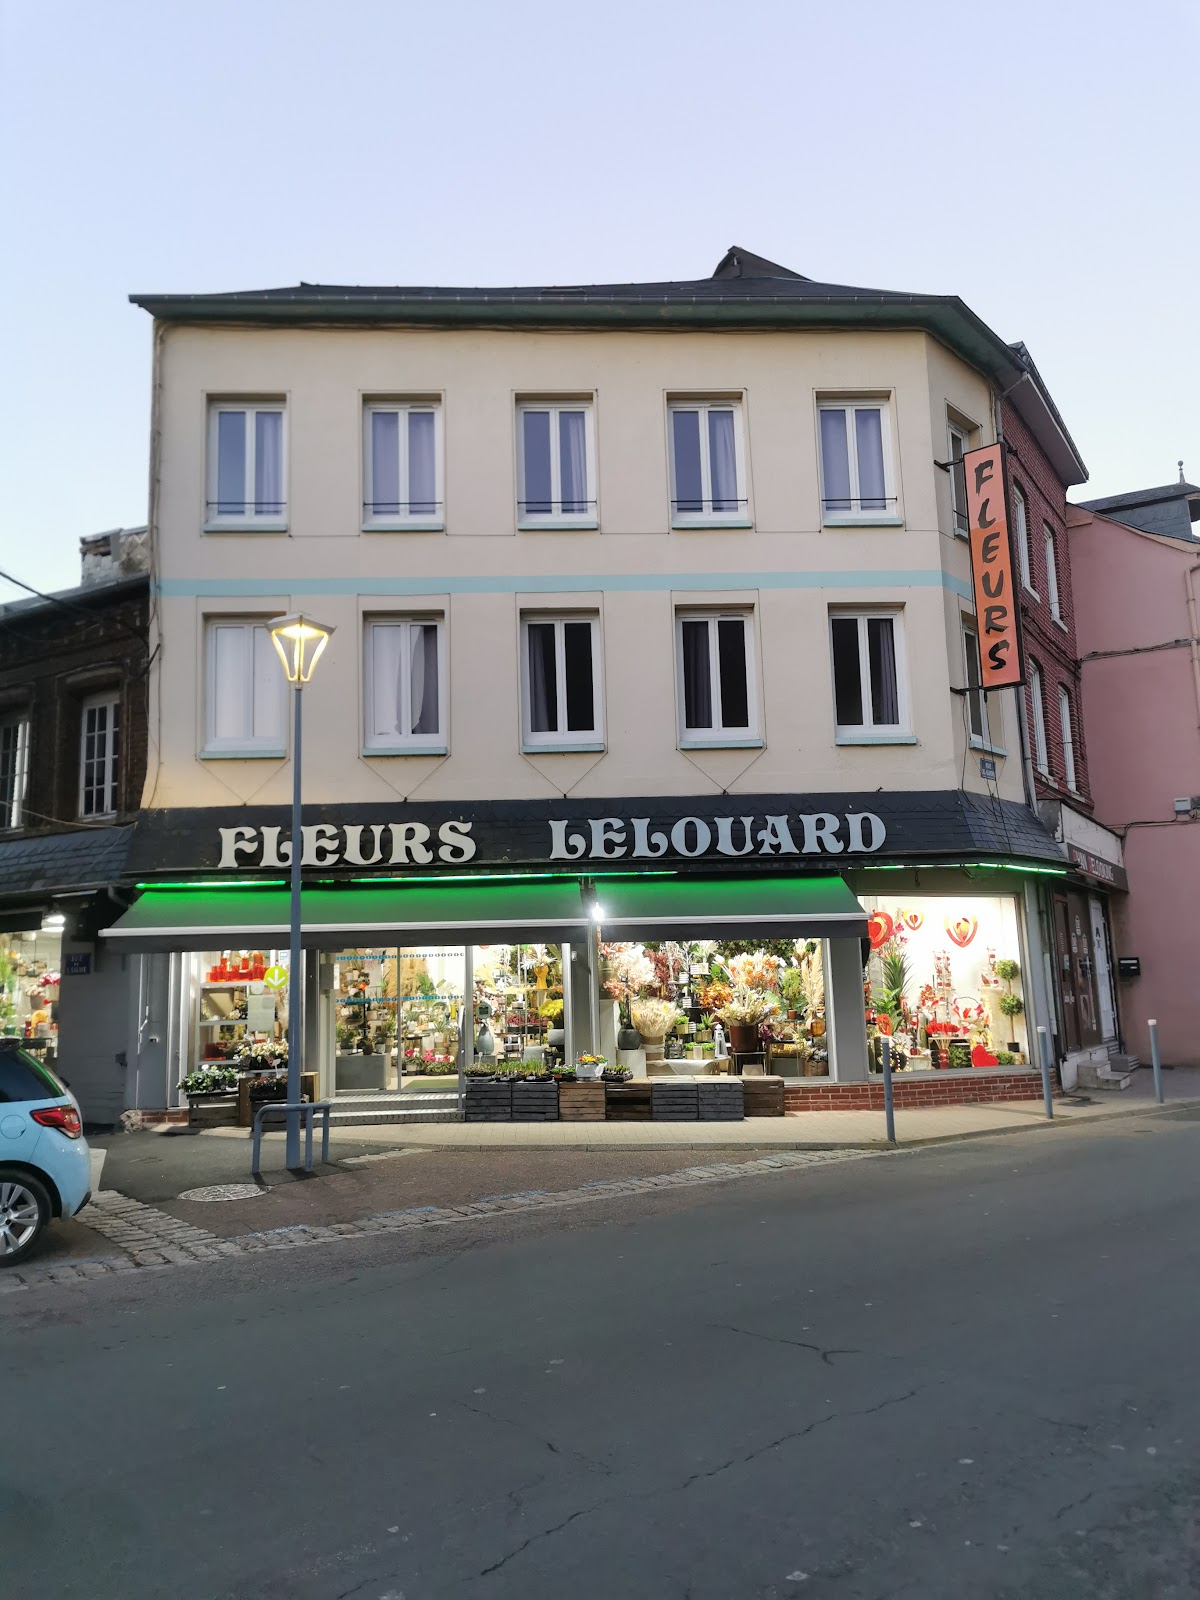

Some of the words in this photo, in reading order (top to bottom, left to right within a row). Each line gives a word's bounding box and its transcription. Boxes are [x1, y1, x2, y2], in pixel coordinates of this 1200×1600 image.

[974, 459, 1010, 671] FLEURS
[217, 820, 477, 868] FLEURS
[548, 812, 887, 859] LELOUARD
